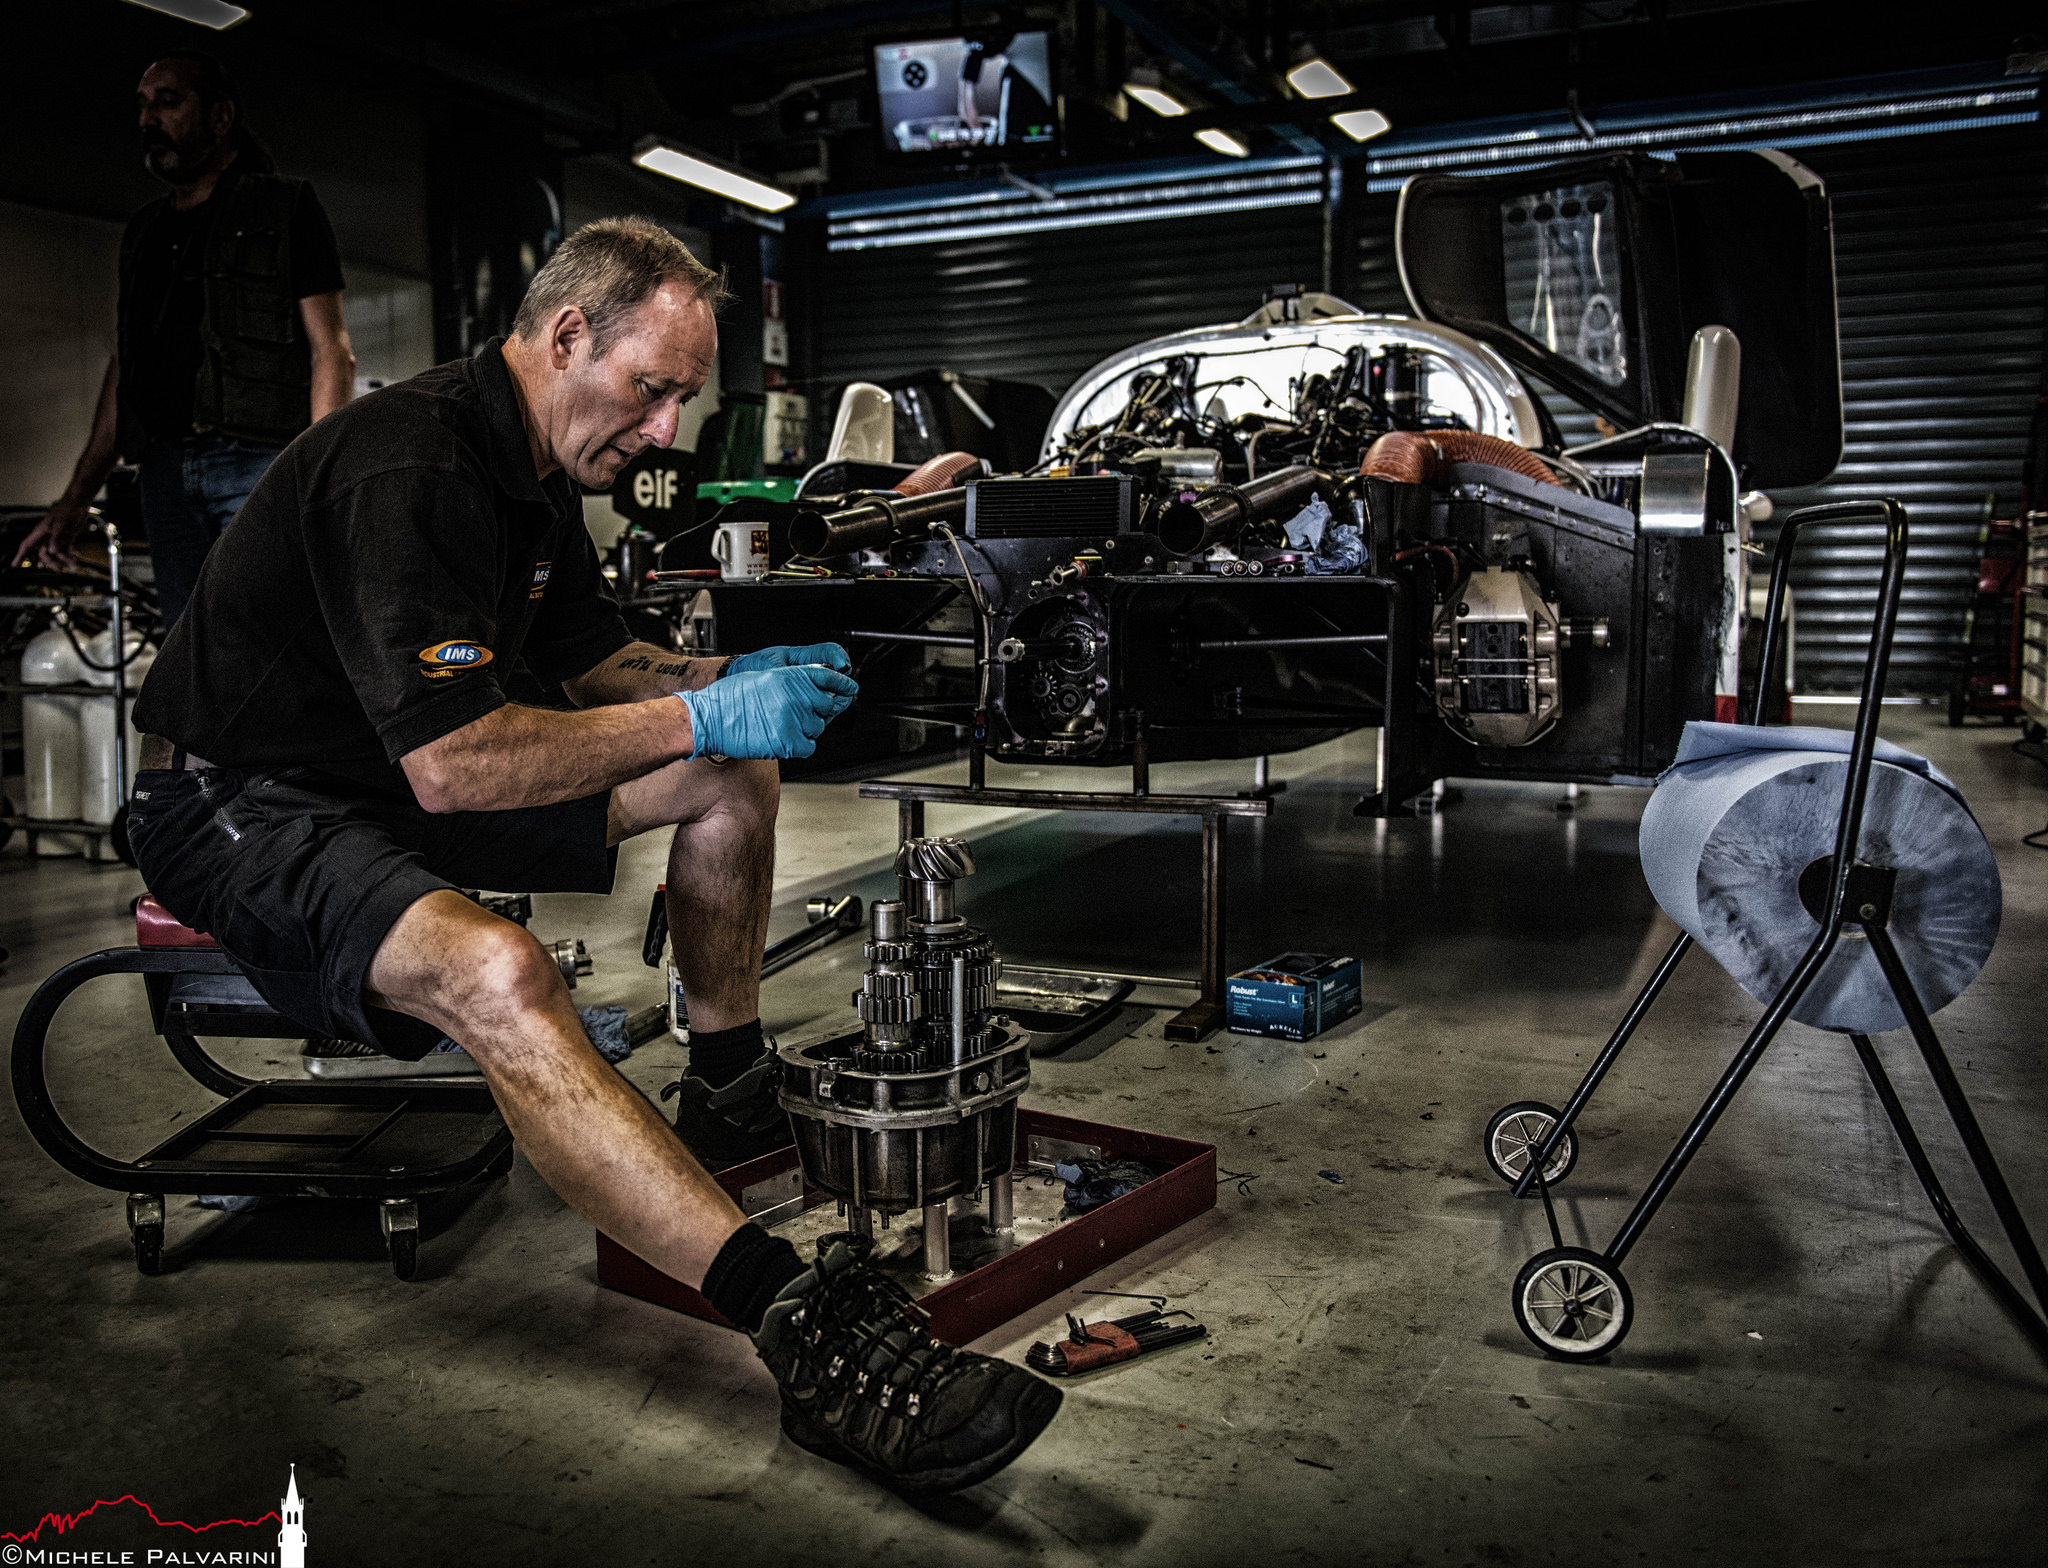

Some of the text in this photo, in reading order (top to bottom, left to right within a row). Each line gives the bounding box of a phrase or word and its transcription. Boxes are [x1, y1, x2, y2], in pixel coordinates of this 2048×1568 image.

[534, 570, 550, 582] MS
[444, 647, 475, 661] IMS
[1230, 985, 1257, 996] Robust
[1291, 994, 1298, 1004] L
